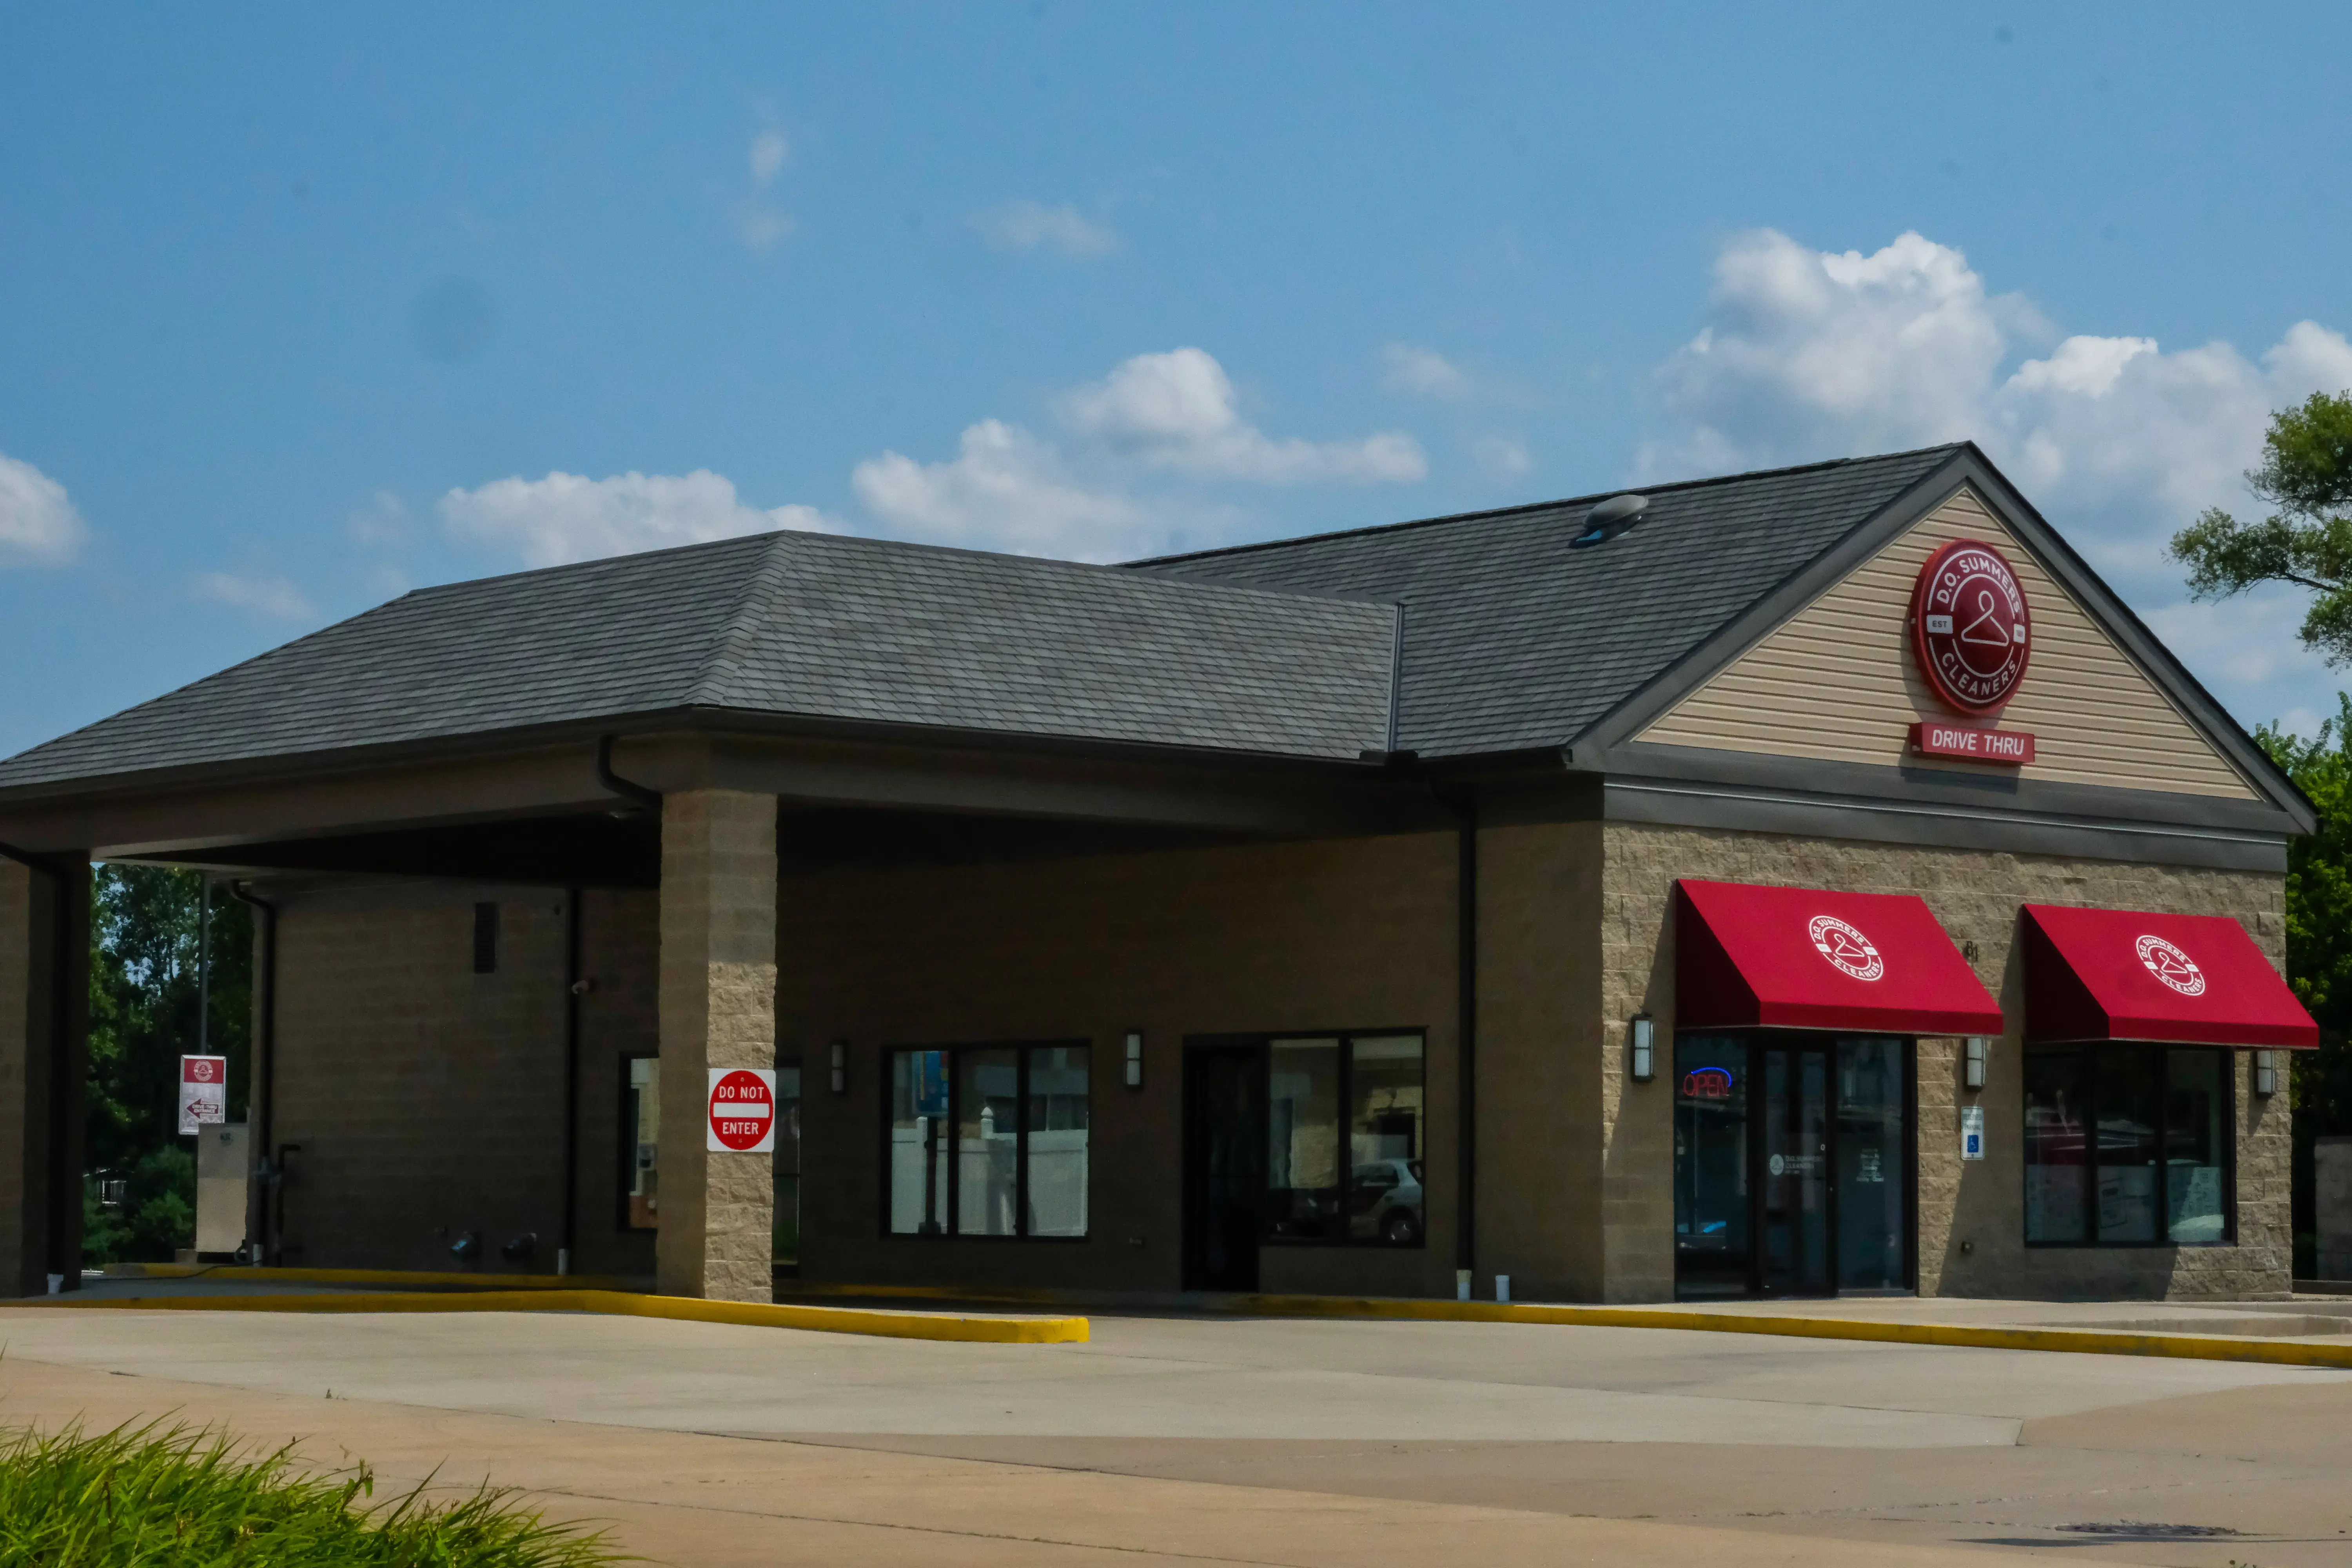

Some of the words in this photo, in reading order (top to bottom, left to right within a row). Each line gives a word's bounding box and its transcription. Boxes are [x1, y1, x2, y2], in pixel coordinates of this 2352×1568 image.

[1936, 572, 1960, 604] D.O.
[1960, 556, 2020, 613] SUMMERS
[1942, 652, 2016, 695] CLEANERS
[1932, 729, 1977, 751] DRIVE
[1984, 734, 2024, 756] THRU
[1817, 918, 1864, 943] SUMMERS
[2142, 938, 2186, 960] SUMMERS
[1834, 959, 1880, 978] CLEANERS
[2161, 975, 2202, 993] CLEANERS
[719, 1085, 735, 1099] DO
[740, 1086, 764, 1099] NOT
[1683, 1074, 1729, 1096] OPEN
[722, 1122, 759, 1135] ENTER
